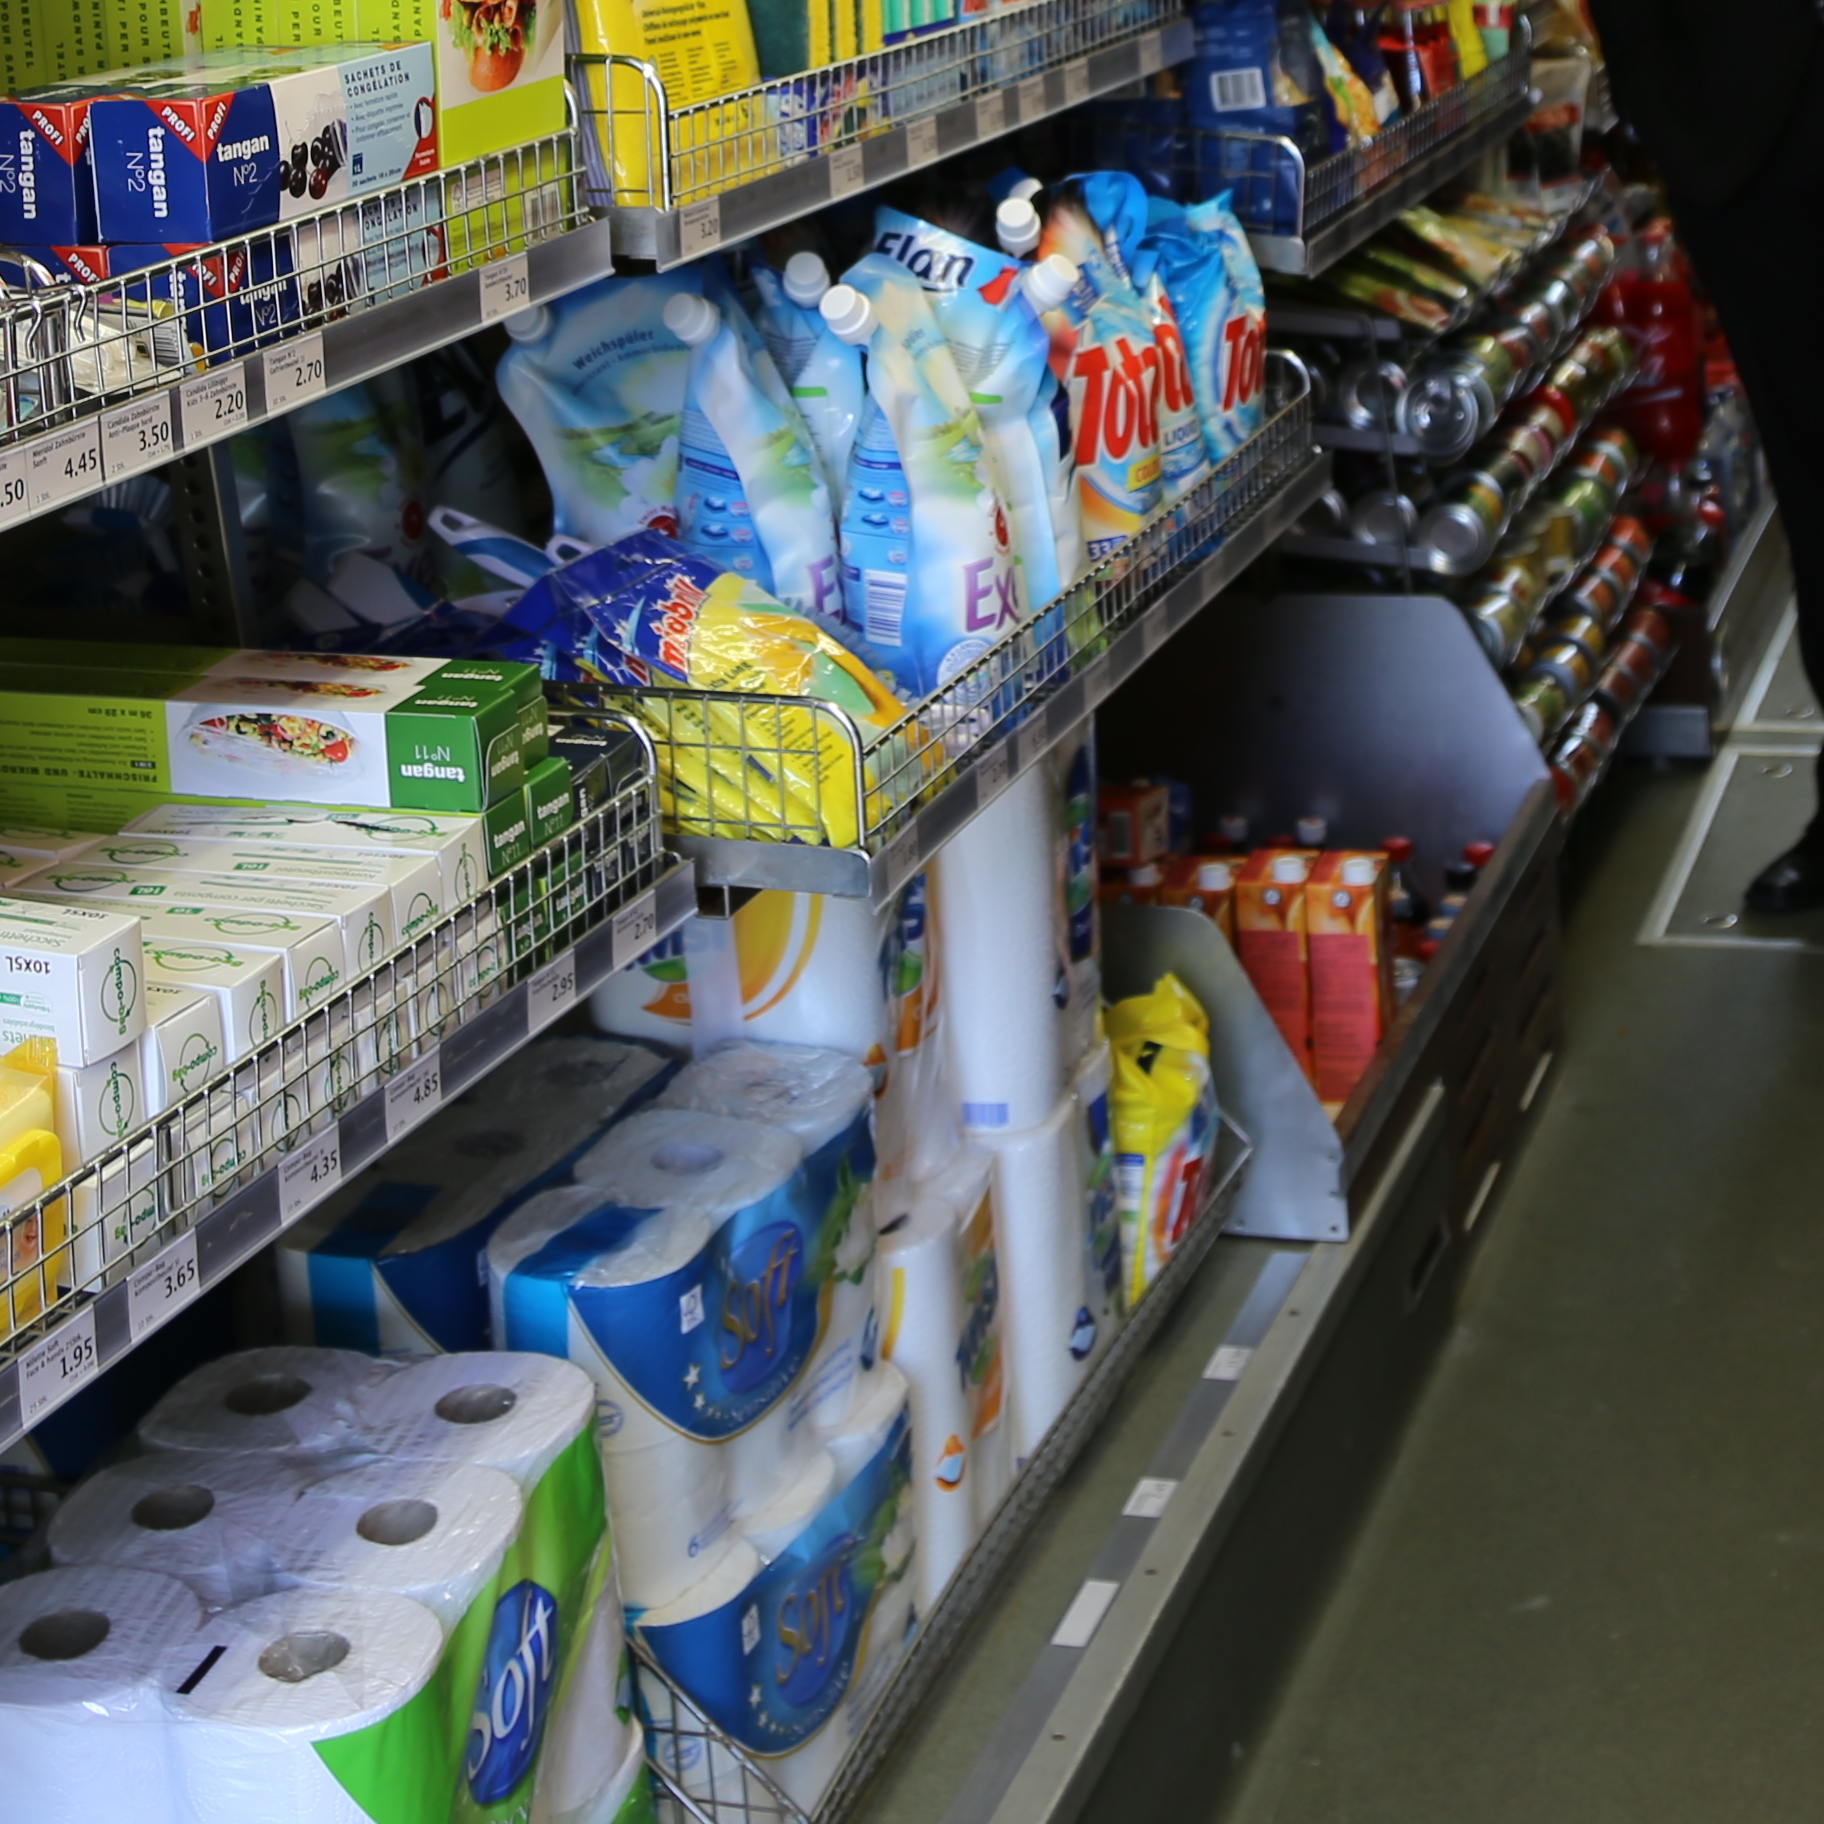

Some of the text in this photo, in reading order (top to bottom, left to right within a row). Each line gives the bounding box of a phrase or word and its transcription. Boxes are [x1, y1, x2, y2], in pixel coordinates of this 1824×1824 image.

[138, 2, 150, 47] POUR
[292, 10, 302, 43] PER
[344, 60, 402, 86] SACHETS DE
[346, 71, 412, 98] CONGÉLATION
[30, 109, 65, 147] PROFI
[160, 105, 196, 144] PROFI
[205, 100, 228, 141] PROFI
[216, 134, 270, 163] tangan
[18, 128, 37, 221] tangan
[147, 125, 170, 219] tangan
[696, 215, 719, 242] 3.20
[503, 275, 529, 304] 3.70
[295, 358, 322, 389] 2.70
[214, 389, 244, 421] 2.20
[138, 420, 170, 453] 3.50
[63, 448, 97, 480] 4.45
[400, 763, 467, 783] tangan
[536, 792, 570, 821] tangan
[493, 820, 526, 848] tangan
[633, 912, 655, 940] 2.70
[4, 954, 51, 975] 10X5L
[112, 947, 127, 1036] compo-bag
[550, 972, 576, 1004] 2.95
[412, 1072, 440, 1110] 4.85
[309, 1151, 338, 1184] 4.35
[164, 1259, 195, 1299] 3.65
[58, 1337, 94, 1379] 1.95
